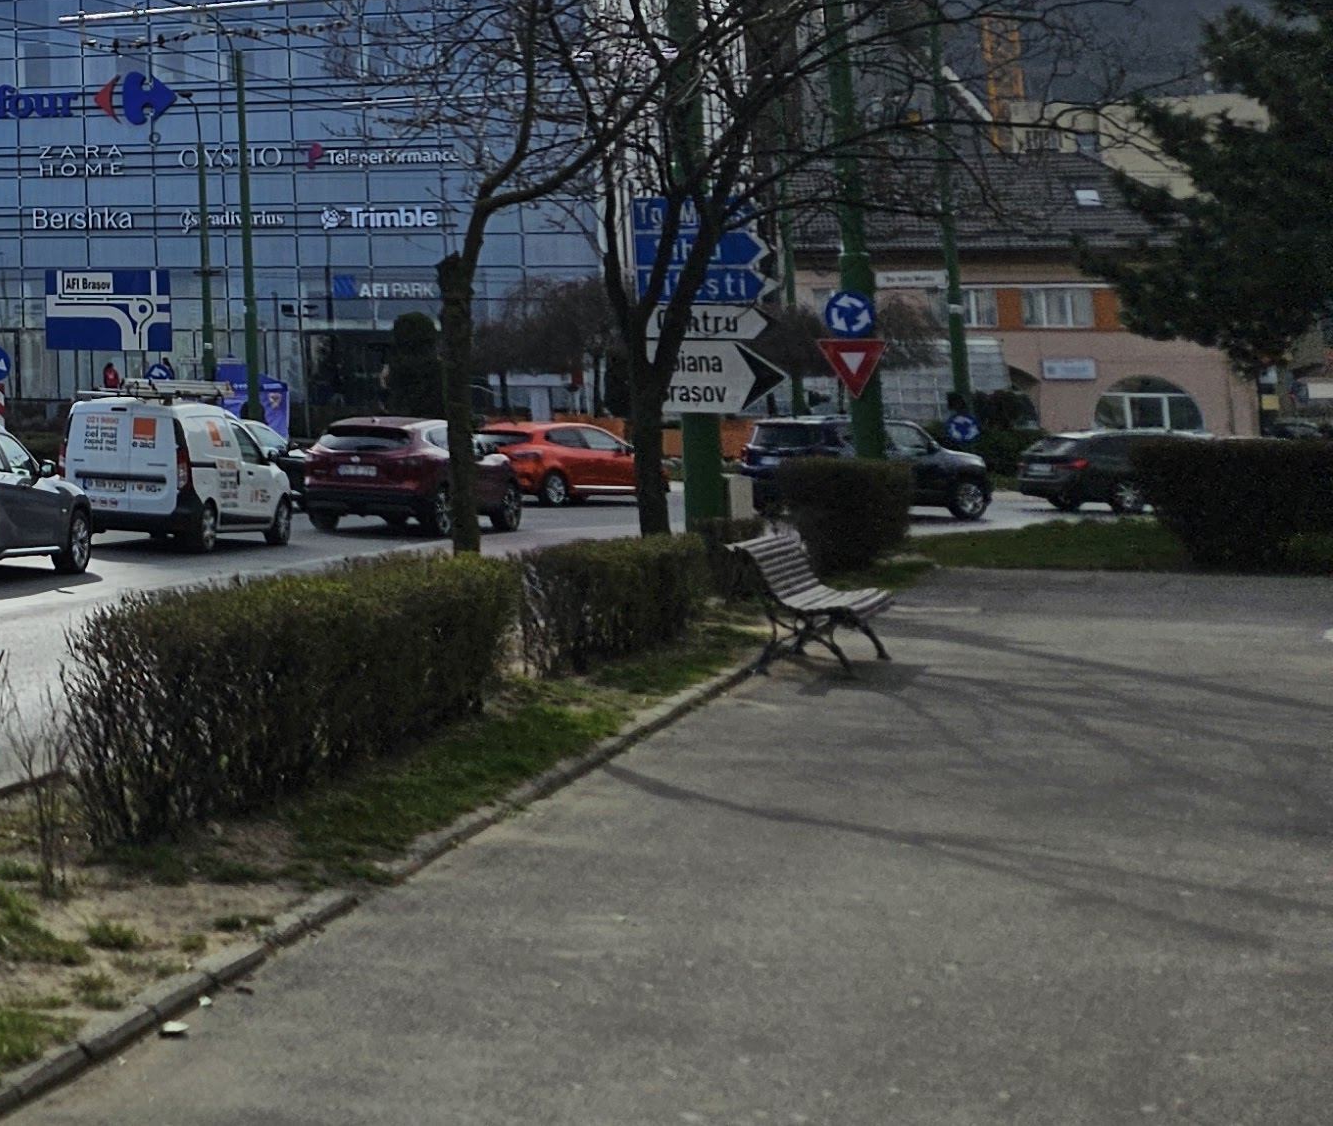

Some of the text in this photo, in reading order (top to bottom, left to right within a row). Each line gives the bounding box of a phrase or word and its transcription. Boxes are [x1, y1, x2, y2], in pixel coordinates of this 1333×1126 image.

[38, 145, 124, 160] ZARA
[326, 148, 460, 168] Teleperformance
[38, 162, 125, 178] HOME
[32, 207, 134, 229] Bershka
[345, 206, 438, 228] Trimble
[66, 278, 111, 291] AFI Brașov
[359, 282, 434, 298] AFI PARK
[674, 351, 723, 374] oiana
[667, 385, 727, 407] rașov
